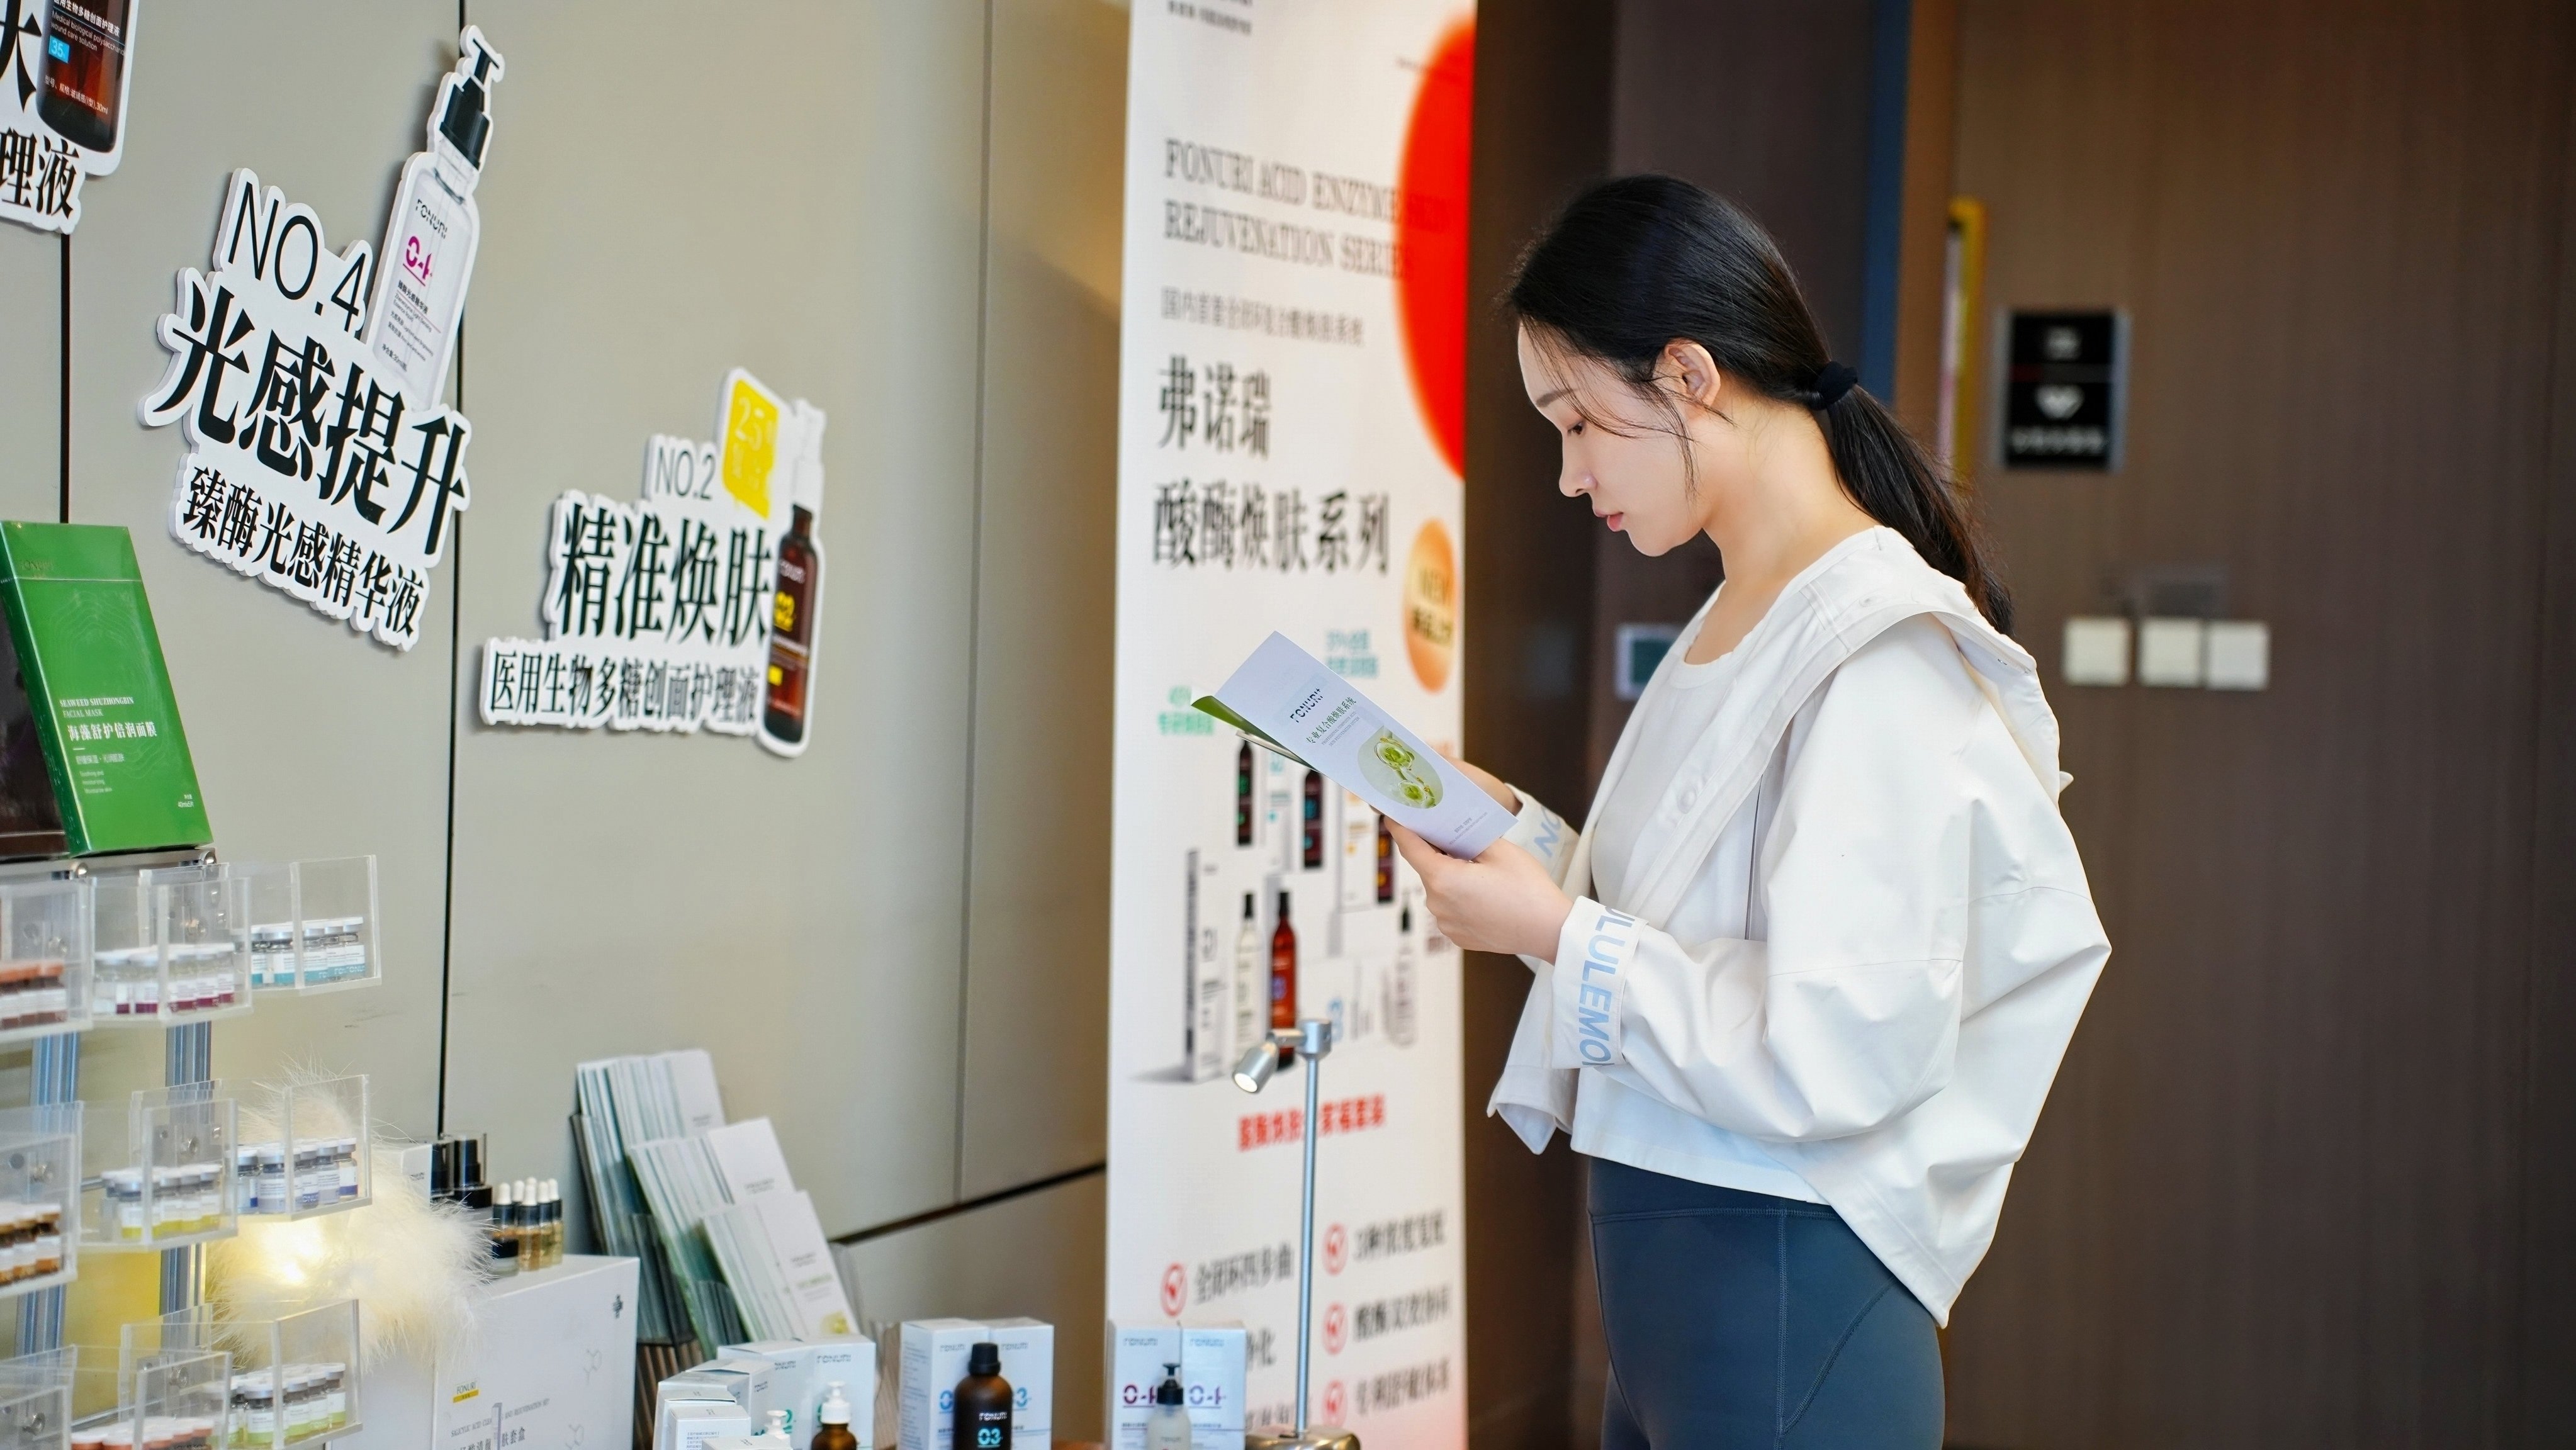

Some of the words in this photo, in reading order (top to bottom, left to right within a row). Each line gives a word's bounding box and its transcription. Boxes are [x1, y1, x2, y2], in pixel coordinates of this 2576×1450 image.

[50, 21, 67, 37] wound
[67, 31, 79, 42] care
[78, 36, 98, 52] solution
[52, 9, 70, 28] Medical
[70, 21, 93, 42] biological
[1259, 162, 1308, 206] ACID
[1311, 172, 1405, 224] ENZYME
[228, 182, 366, 332] NO.4
[1164, 200, 1336, 268] REJUVENATION
[154, 281, 466, 556] 光感提升
[1159, 354, 1273, 461] 弗诺瑞
[654, 446, 717, 501] NO.2
[183, 466, 427, 638] 臻酶光感精华液
[1153, 477, 1391, 576] 酸酶焕肤系列
[556, 502, 773, 648] 精准焕肤
[59, 698, 89, 707] SEAWEED
[64, 709, 85, 719] FACIAL
[85, 709, 104, 717] MASK
[490, 649, 760, 722] 医用生物多糖创面护理液
[67, 721, 157, 741] 海藻舒护倍润面膜
[1306, 696, 1357, 743] 专业复合酸焕肤系统
[940, 1389, 955, 1410] 0
[977, 1428, 1003, 1446] 03
